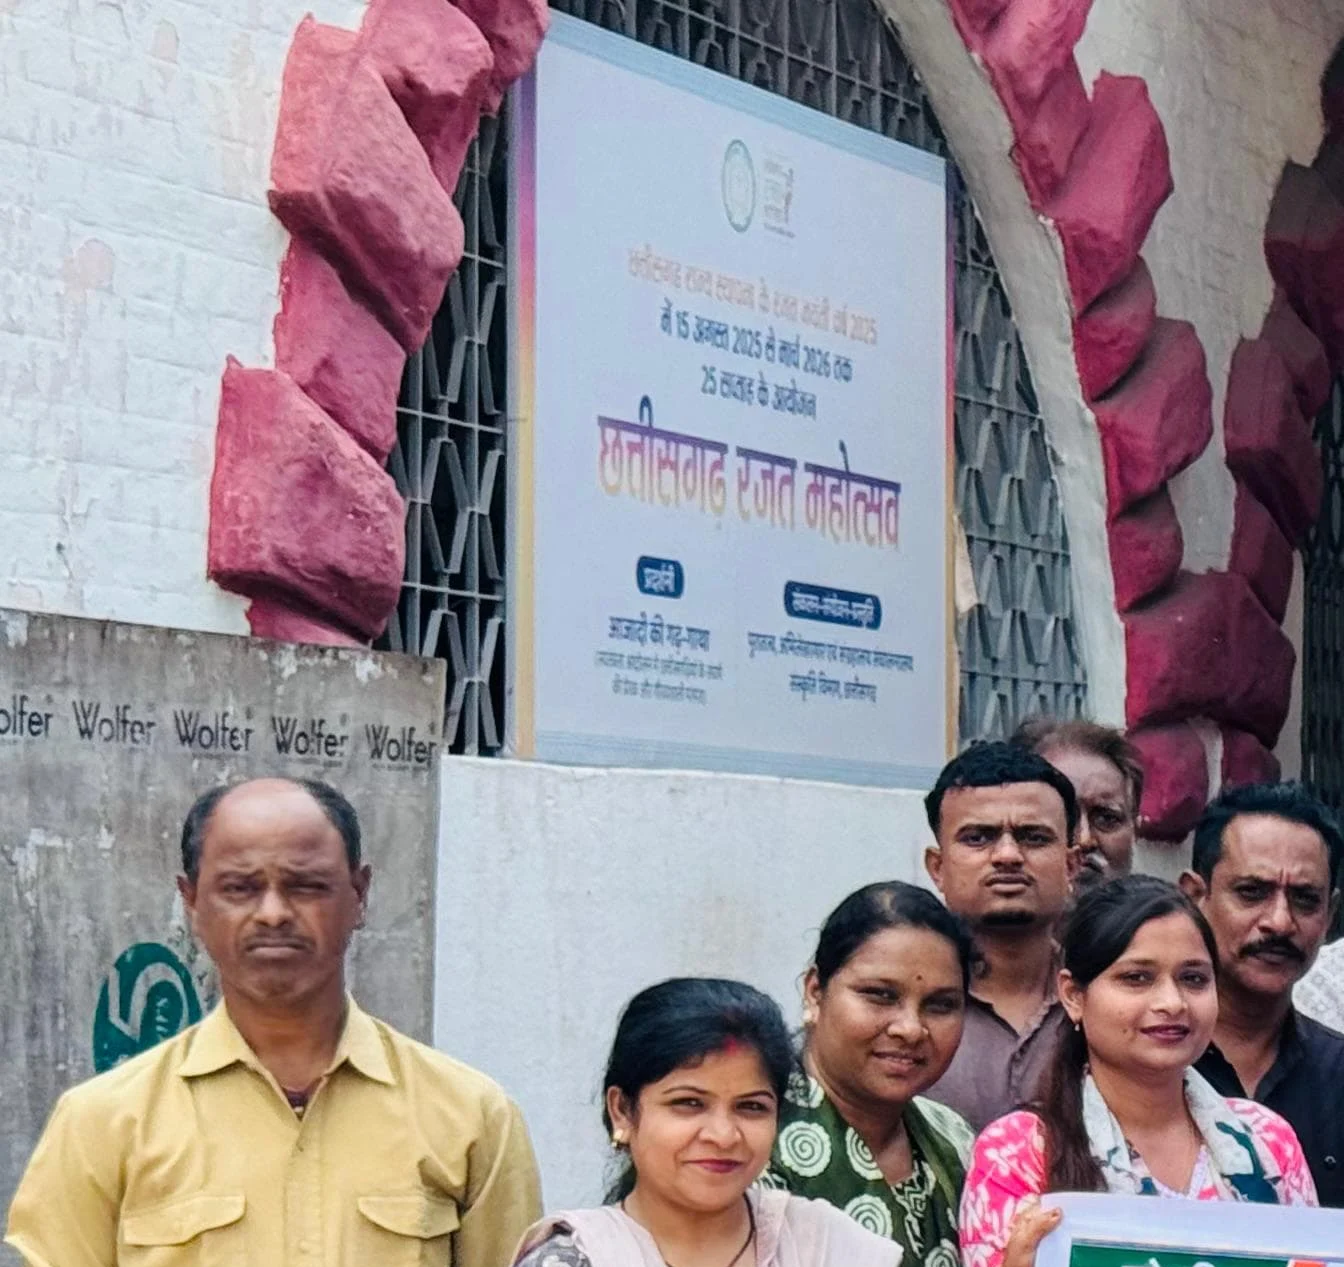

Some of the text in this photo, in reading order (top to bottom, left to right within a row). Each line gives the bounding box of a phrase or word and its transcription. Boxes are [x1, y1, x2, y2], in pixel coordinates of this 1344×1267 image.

[675, 309, 690, 340] 15
[732, 325, 762, 360] 2025
[802, 344, 831, 378] 2026
[701, 364, 717, 396] 25
[598, 395, 901, 548] छत्तीसगढ़ रजत महोत्सव
[0, 694, 437, 768] olfer Wolfer Wolfer Wolfer Wolfer
